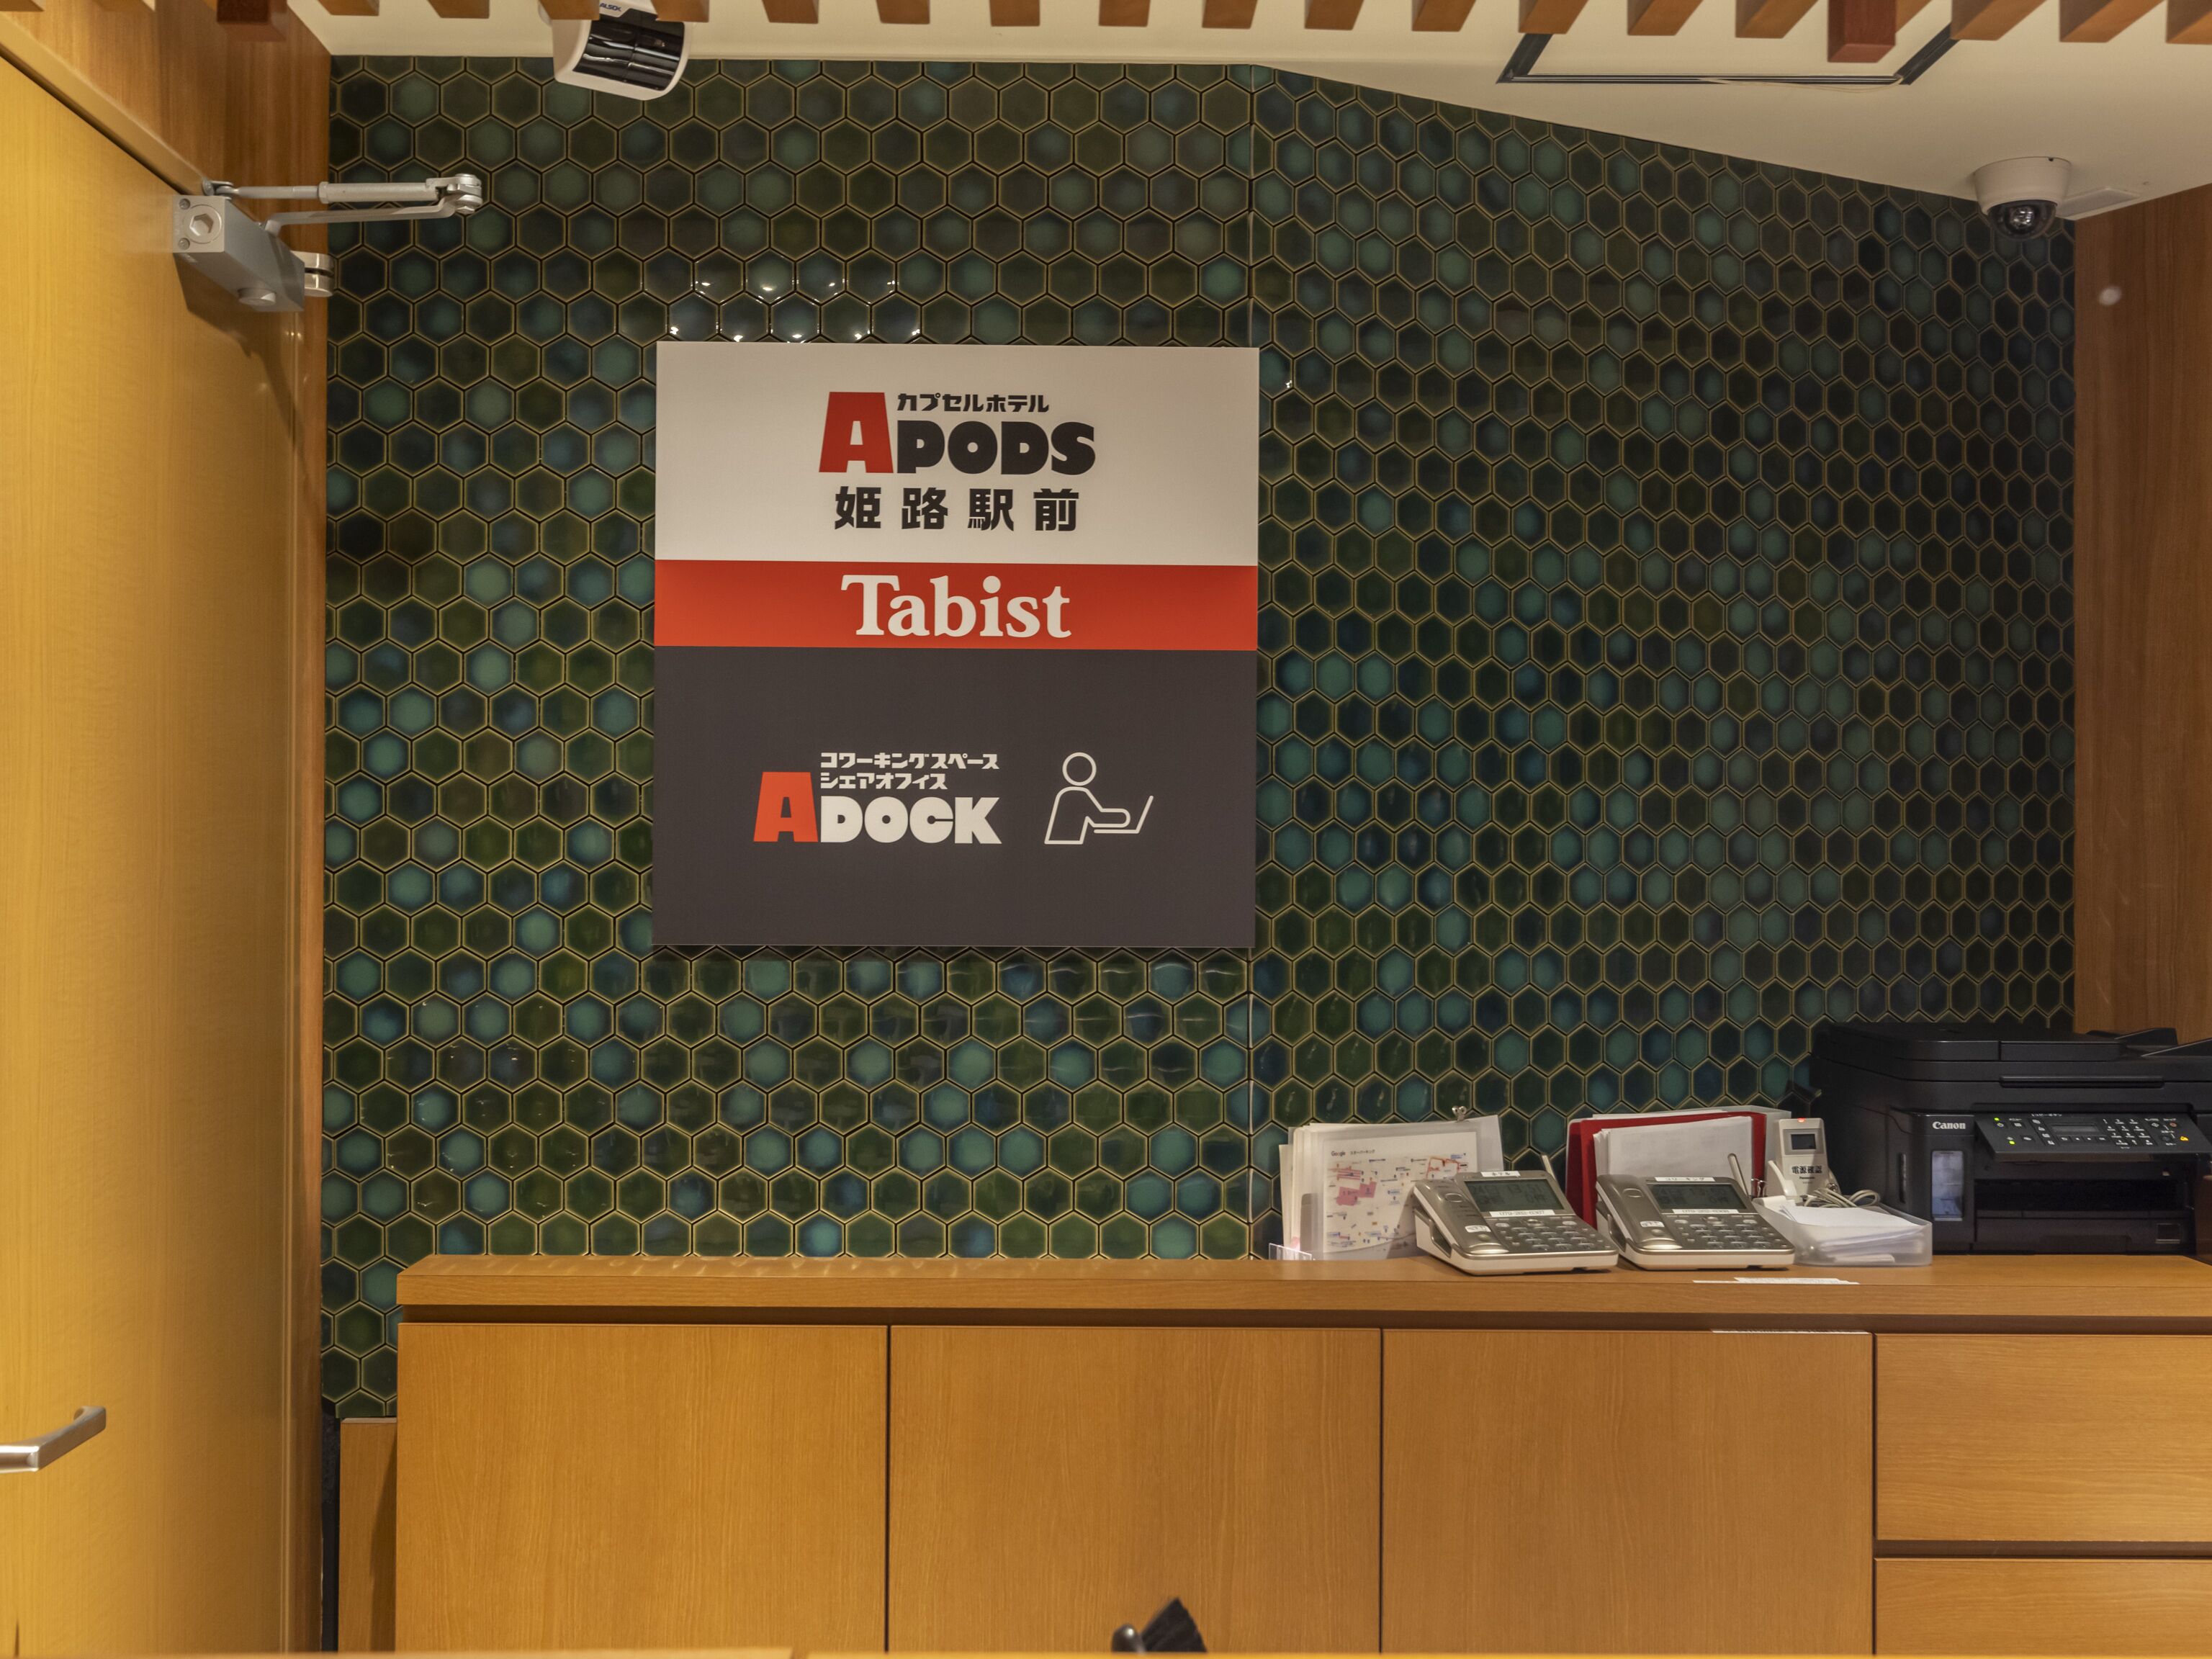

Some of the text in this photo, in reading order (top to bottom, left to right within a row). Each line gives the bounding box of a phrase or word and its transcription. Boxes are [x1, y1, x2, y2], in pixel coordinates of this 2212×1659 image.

[897, 392, 1049, 413] カプセルホテル
[819, 391, 1096, 475] APODS
[835, 486, 1079, 531] 姫路駅前
[841, 575, 1072, 638] Tabist
[821, 752, 1000, 770] コワーキングスペース
[821, 772, 948, 790] シェアオフィス
[753, 771, 1002, 844] ADOCK
